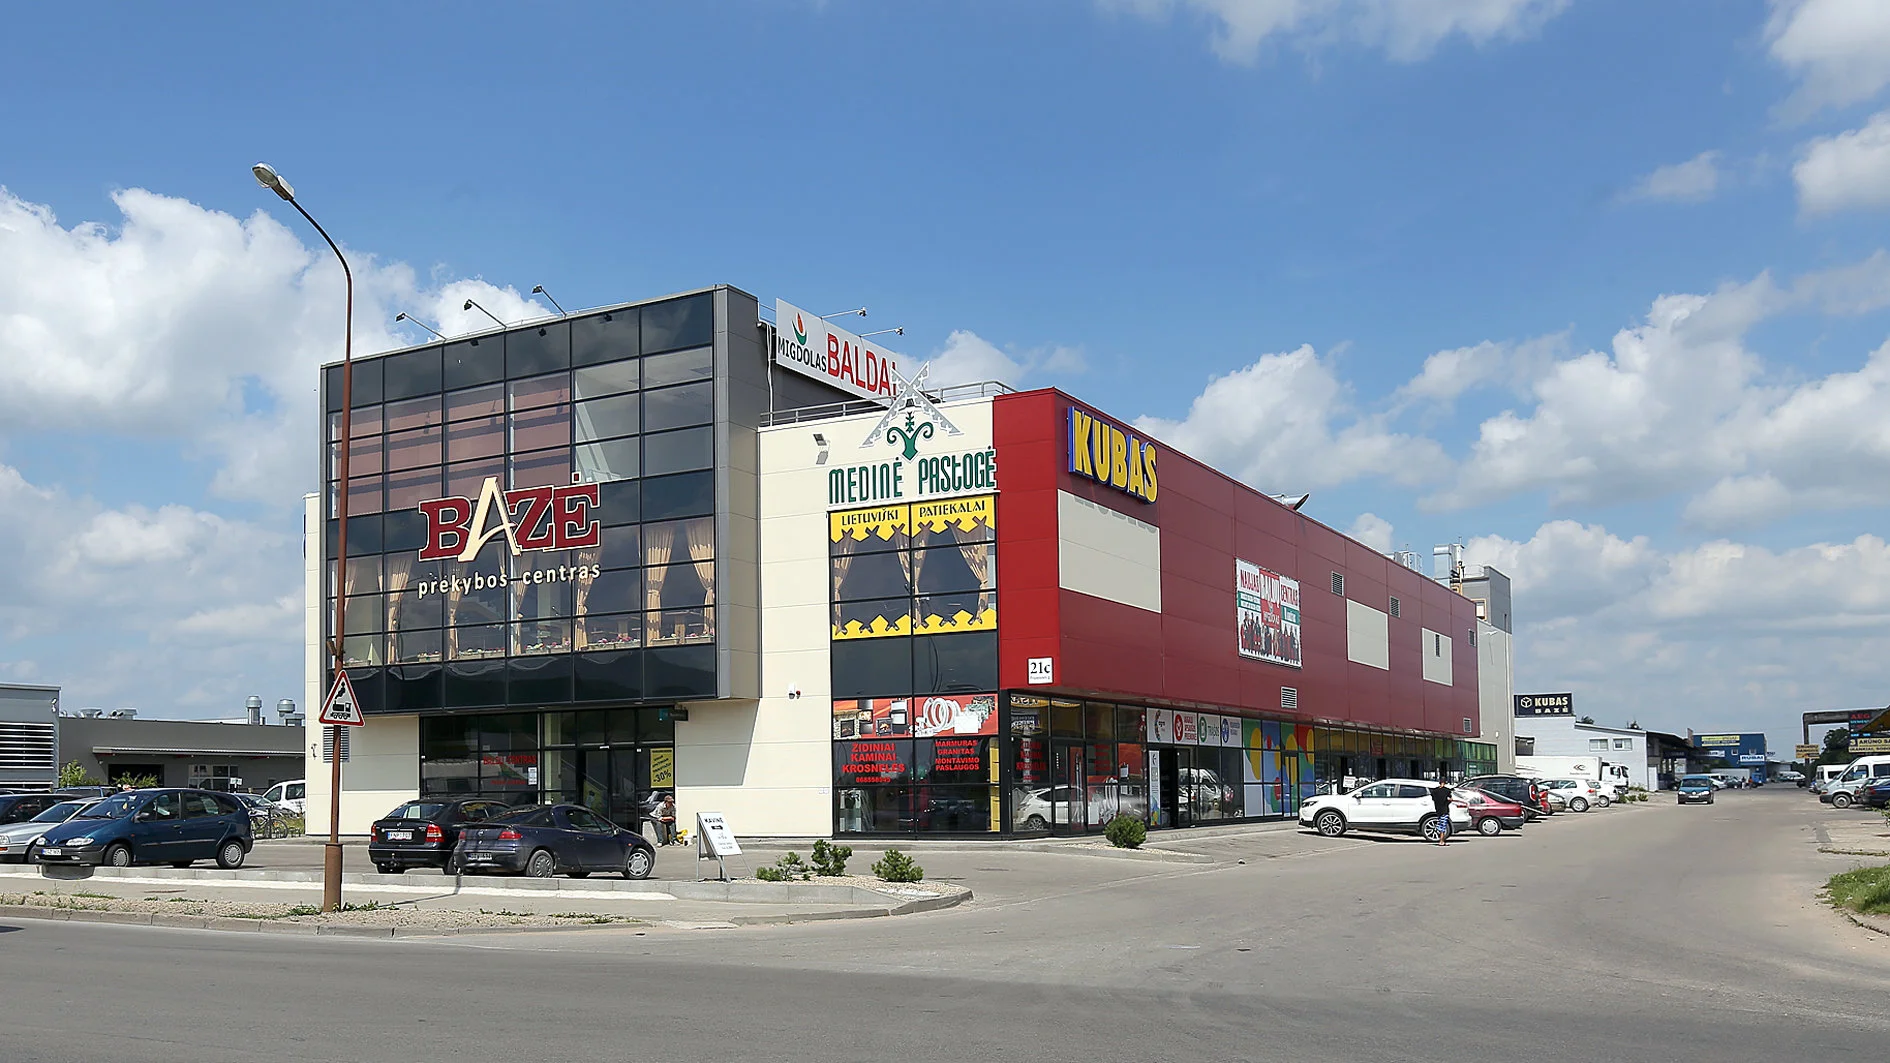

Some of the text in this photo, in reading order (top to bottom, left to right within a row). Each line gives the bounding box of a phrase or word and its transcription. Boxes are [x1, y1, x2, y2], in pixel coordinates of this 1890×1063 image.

[777, 336, 827, 373] MIGDOLAS
[1069, 407, 1158, 504] KUBAS
[828, 456, 903, 505] MEDINĖ
[418, 472, 600, 563] BAZĖ
[841, 499, 986, 527] LIETUVIŠKI PATIEKALAI
[418, 563, 602, 600] prekybos centras
[1030, 662, 1051, 674] 21c
[1534, 696, 1568, 707] KUBAS
[1534, 705, 1569, 714] BAZĖ
[851, 742, 896, 752] ŽIDINIAI
[935, 739, 978, 747] MARMURAS
[850, 753, 897, 762] KAMINAI
